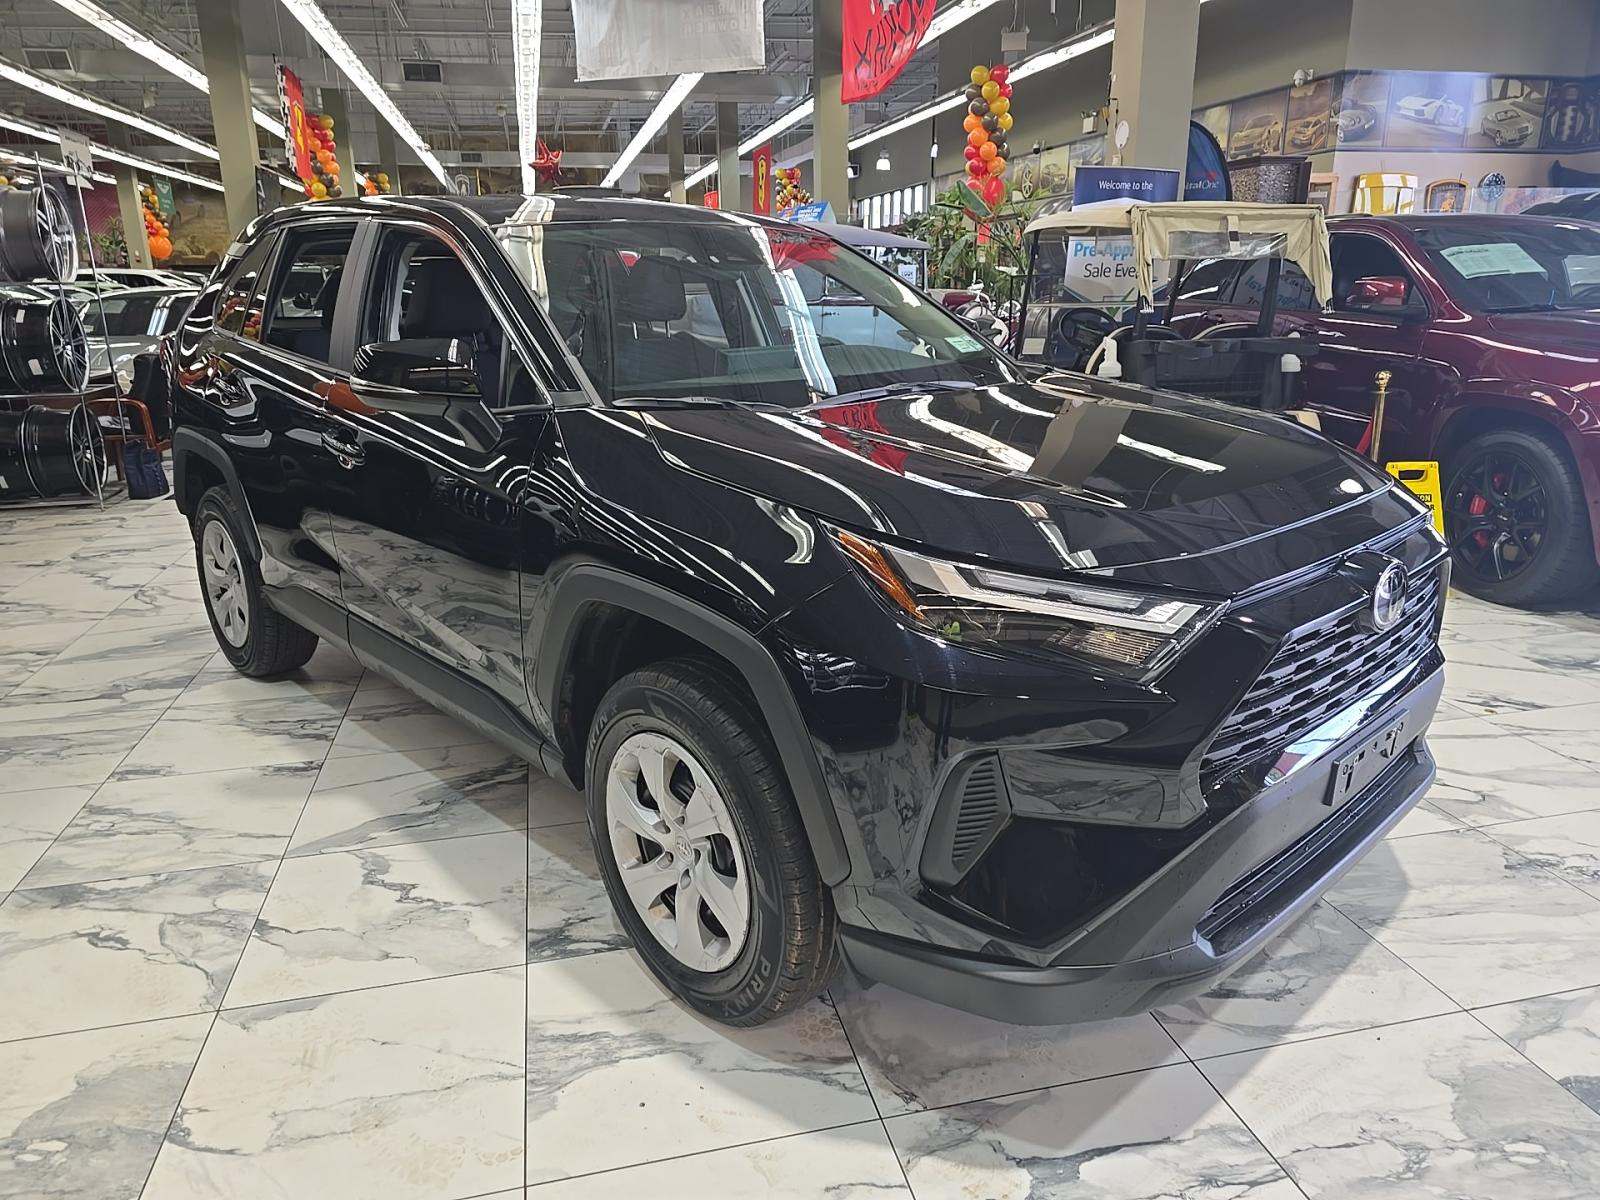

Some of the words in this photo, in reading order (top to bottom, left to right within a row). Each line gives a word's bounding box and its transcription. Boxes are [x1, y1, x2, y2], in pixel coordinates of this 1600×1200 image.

[1098, 180, 1131, 190] Welcome
[1132, 182, 1140, 190] to
[1142, 181, 1153, 190] the
[1073, 241, 1135, 261] Pre-Appr
[1083, 262, 1111, 278] Sale
[1115, 263, 1138, 279] Eve
